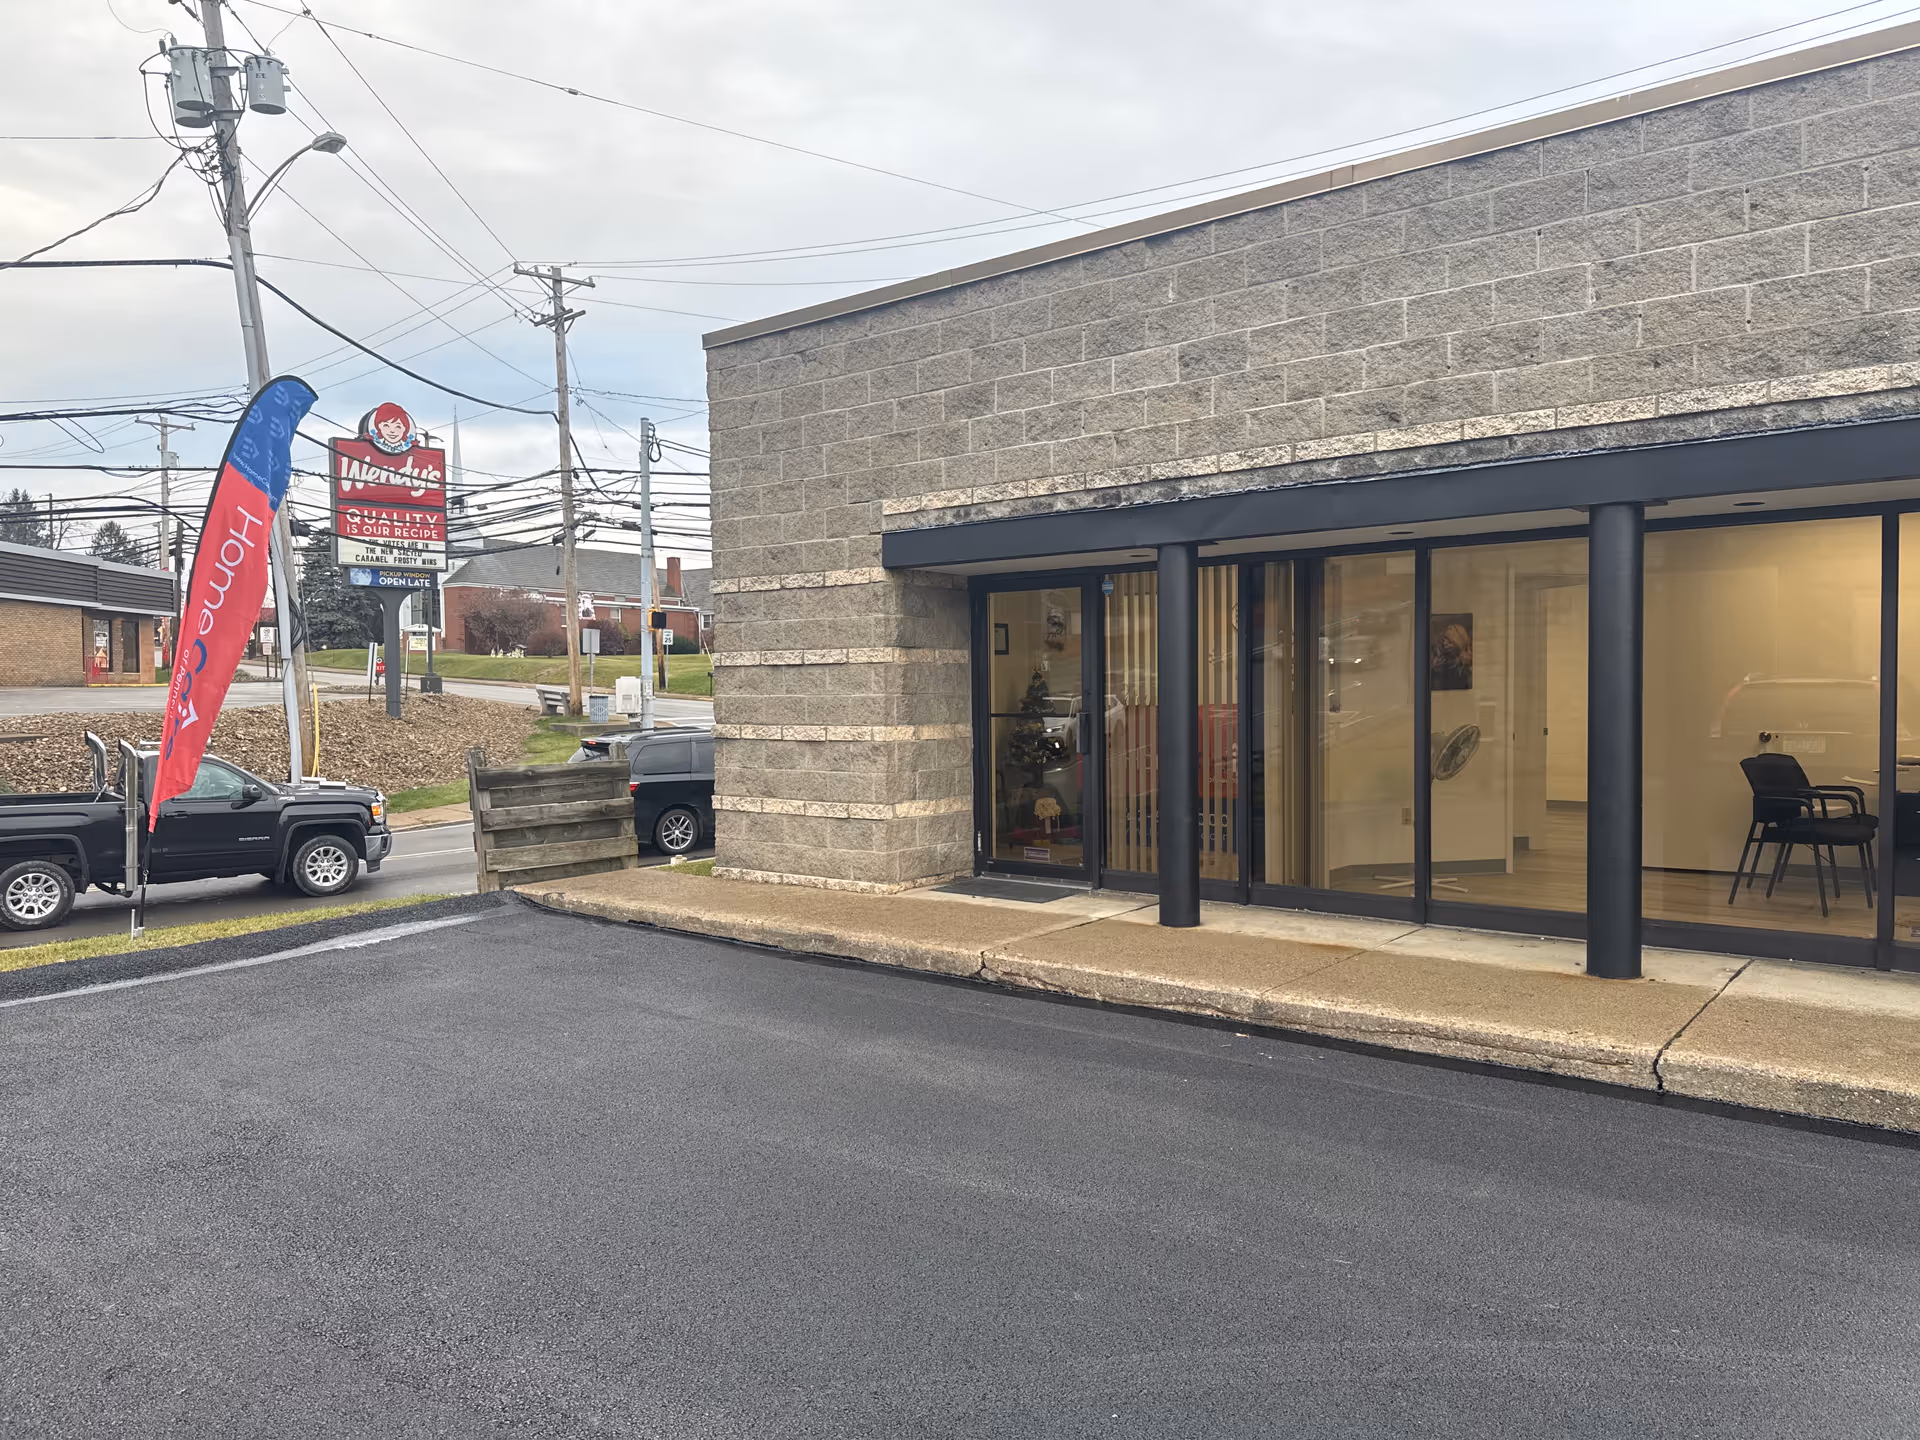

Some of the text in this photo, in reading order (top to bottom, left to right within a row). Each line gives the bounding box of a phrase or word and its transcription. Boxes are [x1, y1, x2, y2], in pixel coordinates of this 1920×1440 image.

[341, 455, 441, 497] Wendy's
[346, 509, 437, 528] QUALITY
[347, 525, 438, 539] IS OUR RECIPE
[381, 547, 393, 555] NEW
[422, 542, 429, 550] IN
[355, 555, 388, 563] CARAMEL
[394, 557, 418, 565] FROSTY
[379, 577, 431, 587] OPEN LATE
